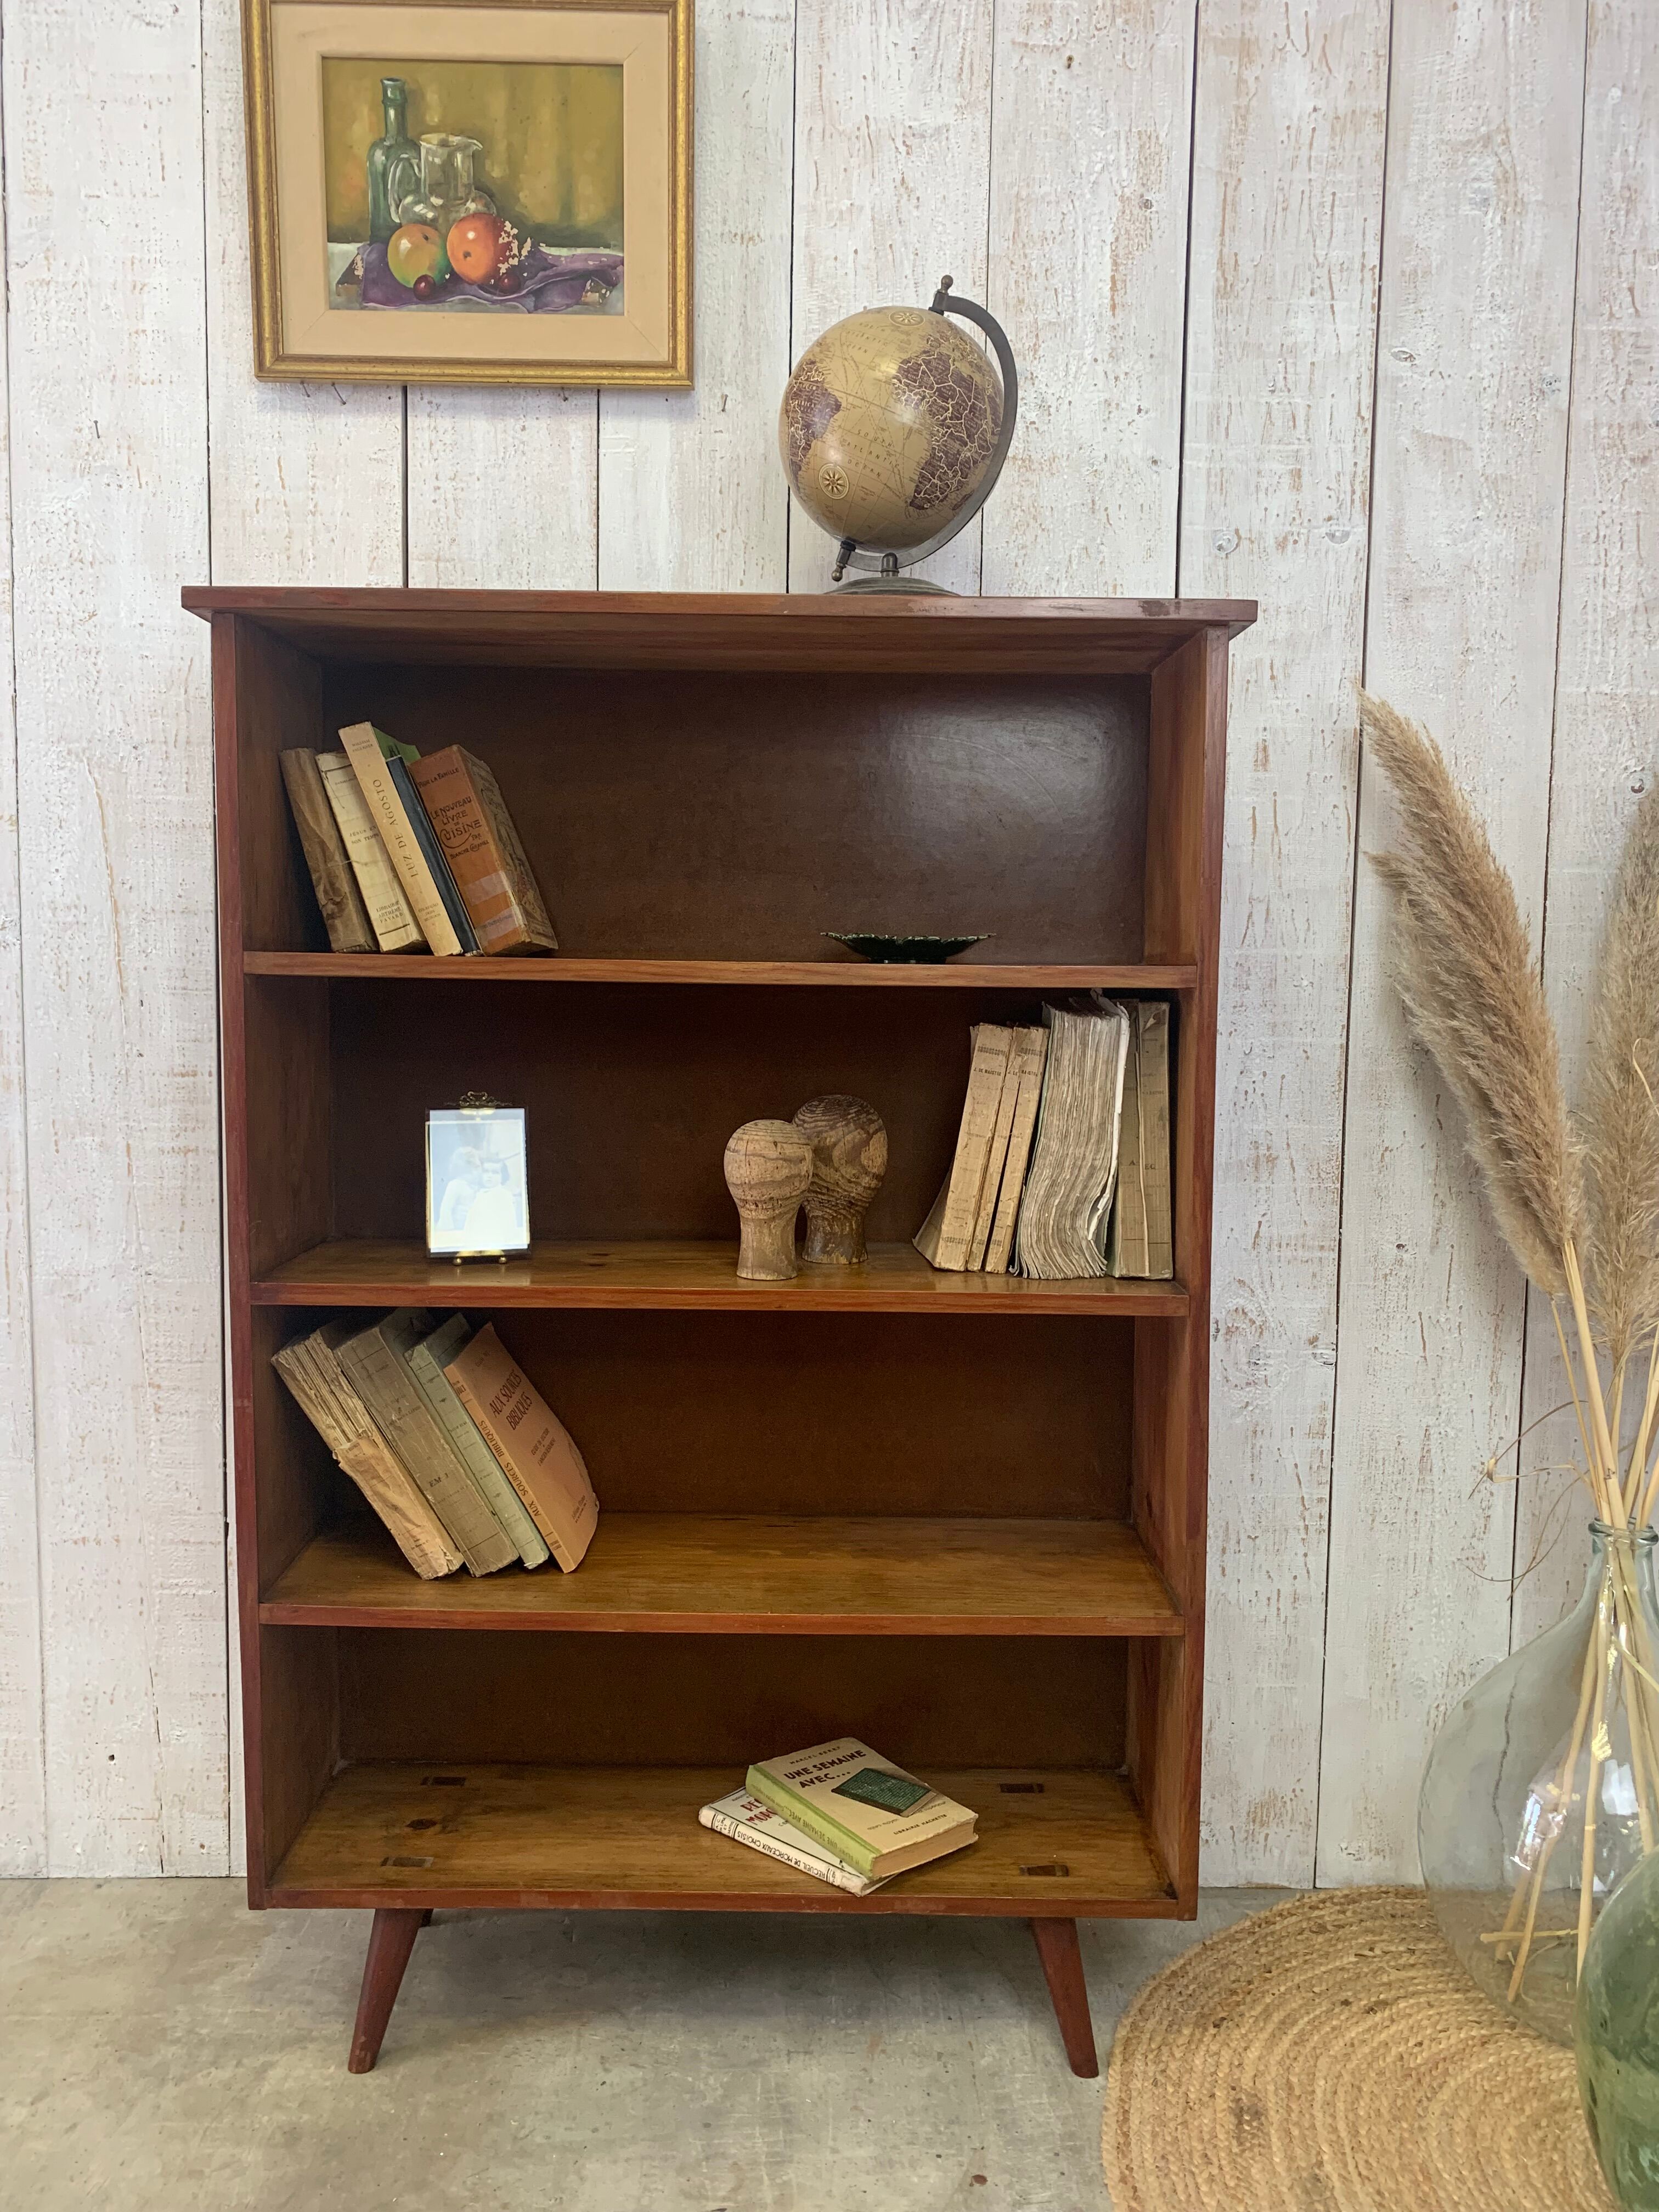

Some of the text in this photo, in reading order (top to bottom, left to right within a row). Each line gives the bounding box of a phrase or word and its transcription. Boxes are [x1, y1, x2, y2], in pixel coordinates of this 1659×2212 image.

[856, 428, 893, 448] SOUTH
[847, 441, 900, 468] ATLANTIC
[847, 459, 882, 477] OCEAN
[437, 768, 460, 780] FAMILLE
[430, 796, 472, 820] LE NOUVEAU
[442, 810, 468, 826] LIVRE
[373, 779, 419, 878] LUZ DE AGOSTO
[439, 819, 483, 849] CUISINE
[984, 1068, 1002, 1076] MAISTRE
[489, 1369, 522, 1418] AUX SOURCES
[506, 1391, 533, 1431] BIBLIQUES
[478, 1420, 505, 1458] BIBLIQUES
[504, 1462, 529, 1497] SOURCES
[528, 1500, 541, 1516] AUX
[783, 1750, 867, 1780] UNE SEMAINE
[789, 1754, 817, 1765] MARCEL
[799, 1771, 851, 1788] AVEC...
[893, 1814, 947, 1835] LIBRAIRIE HACHETTE
[737, 1831, 761, 1847] CHOISIS
[762, 1842, 793, 1863] MORCEAUX
[793, 1858, 802, 1867] DE
[803, 1861, 826, 1880] RECUEIL
